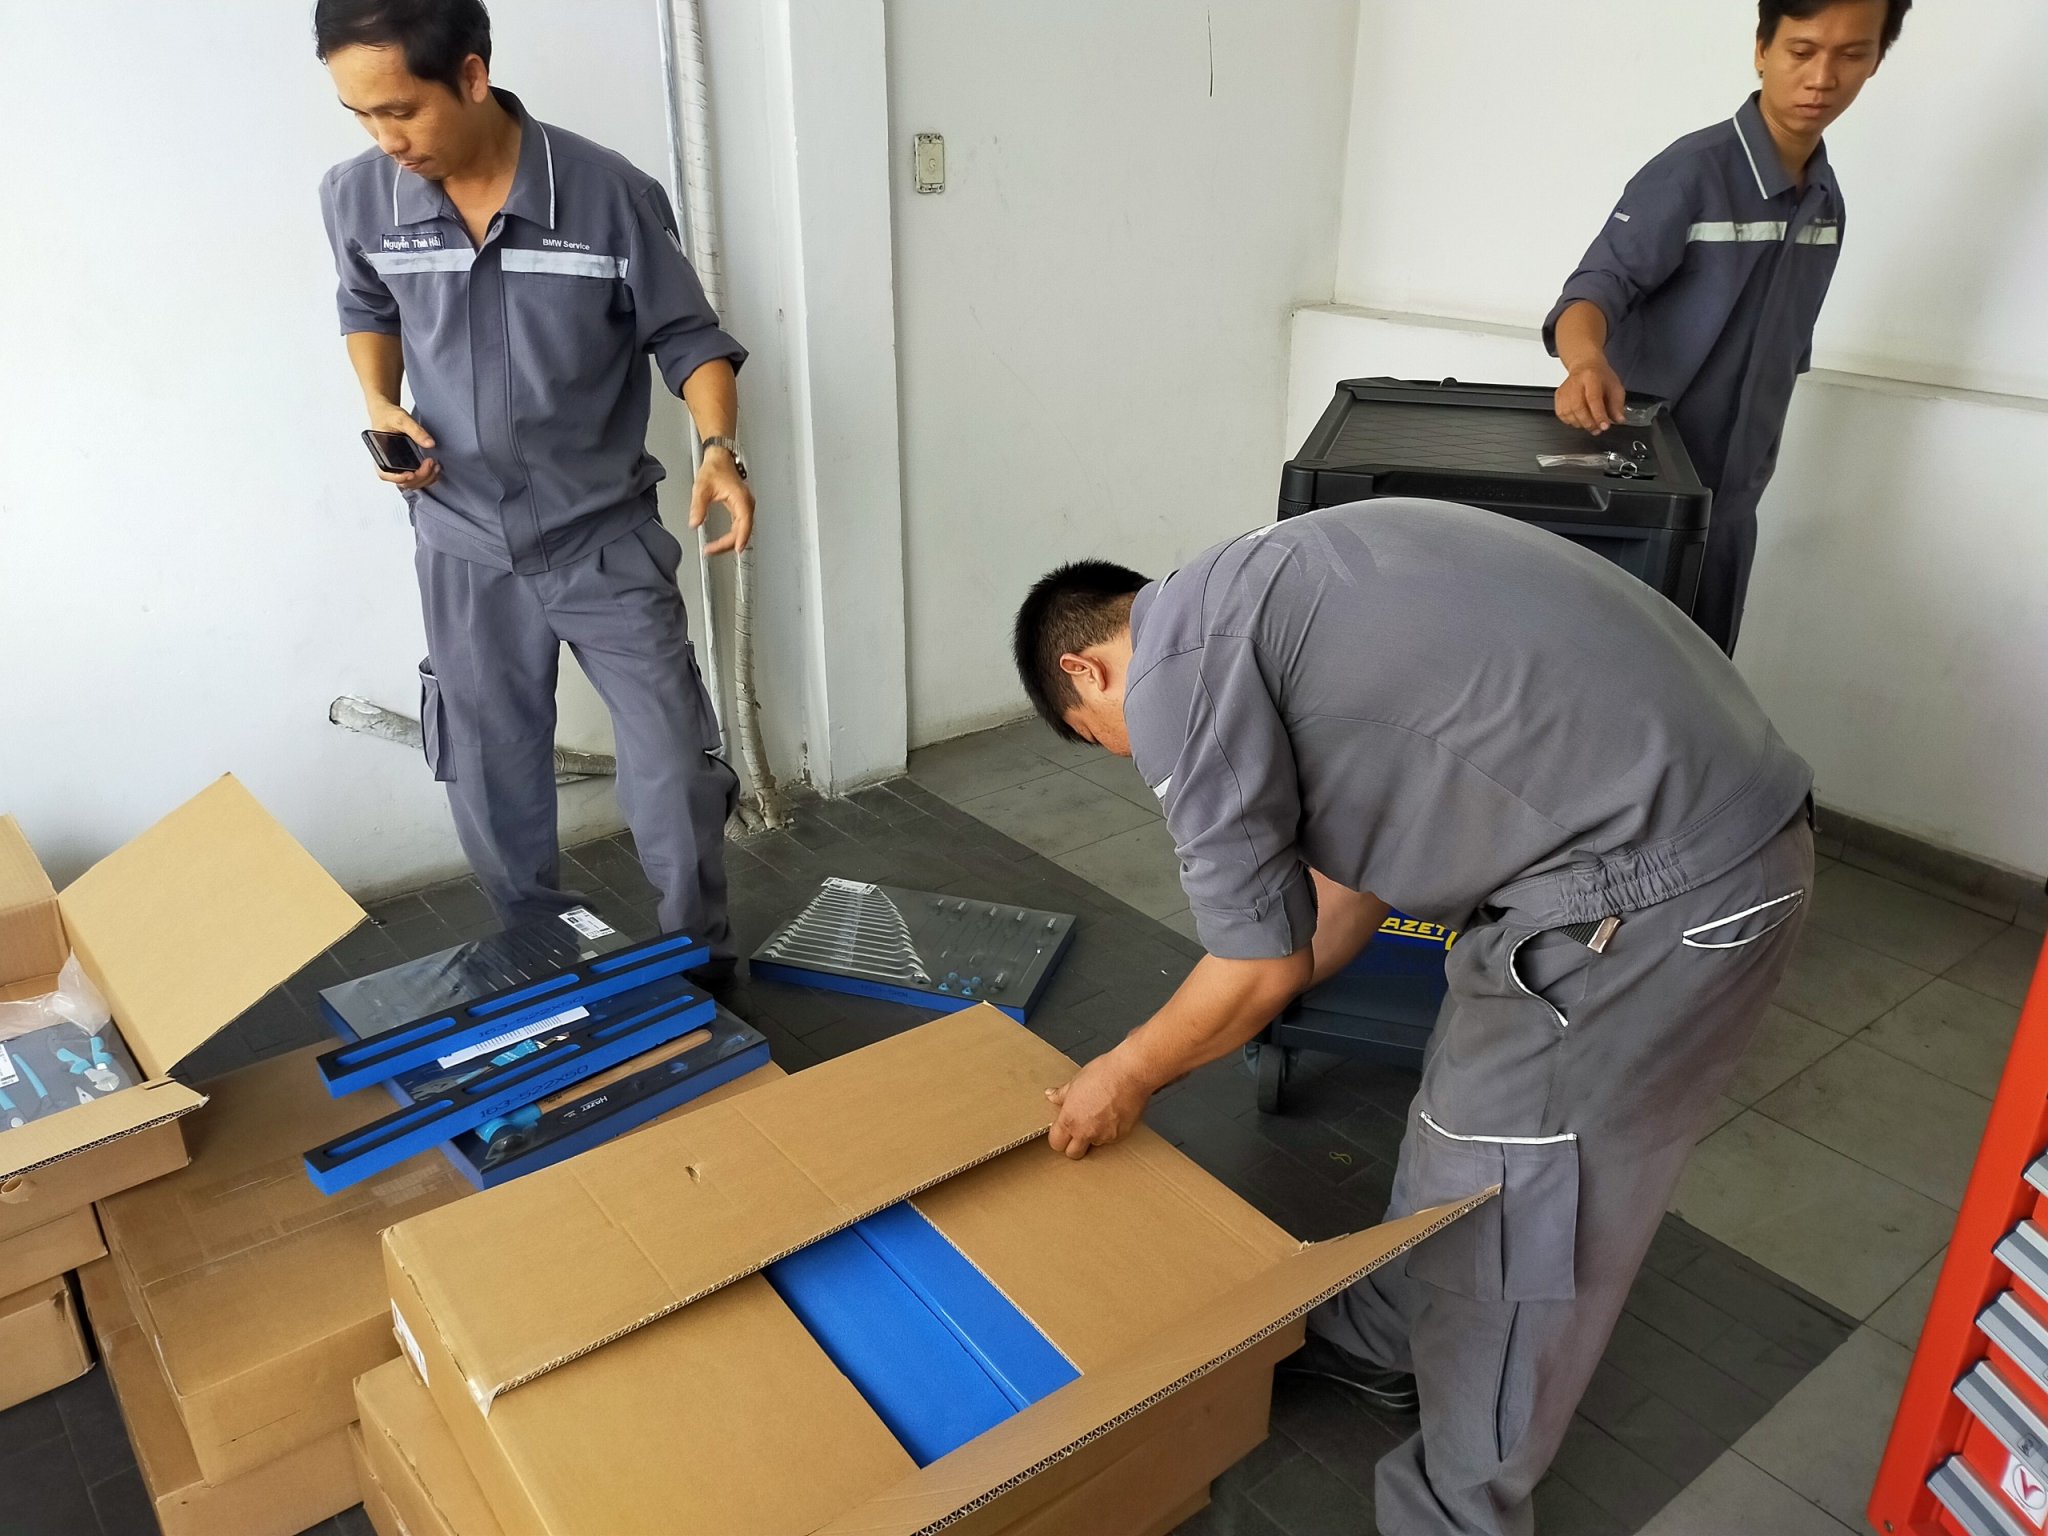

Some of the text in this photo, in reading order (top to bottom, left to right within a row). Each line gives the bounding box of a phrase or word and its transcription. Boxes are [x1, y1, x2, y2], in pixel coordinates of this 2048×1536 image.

[542, 238, 591, 251] BMW Service
[1380, 916, 1447, 936] AZET
[580, 1095, 608, 1112] HAZET
